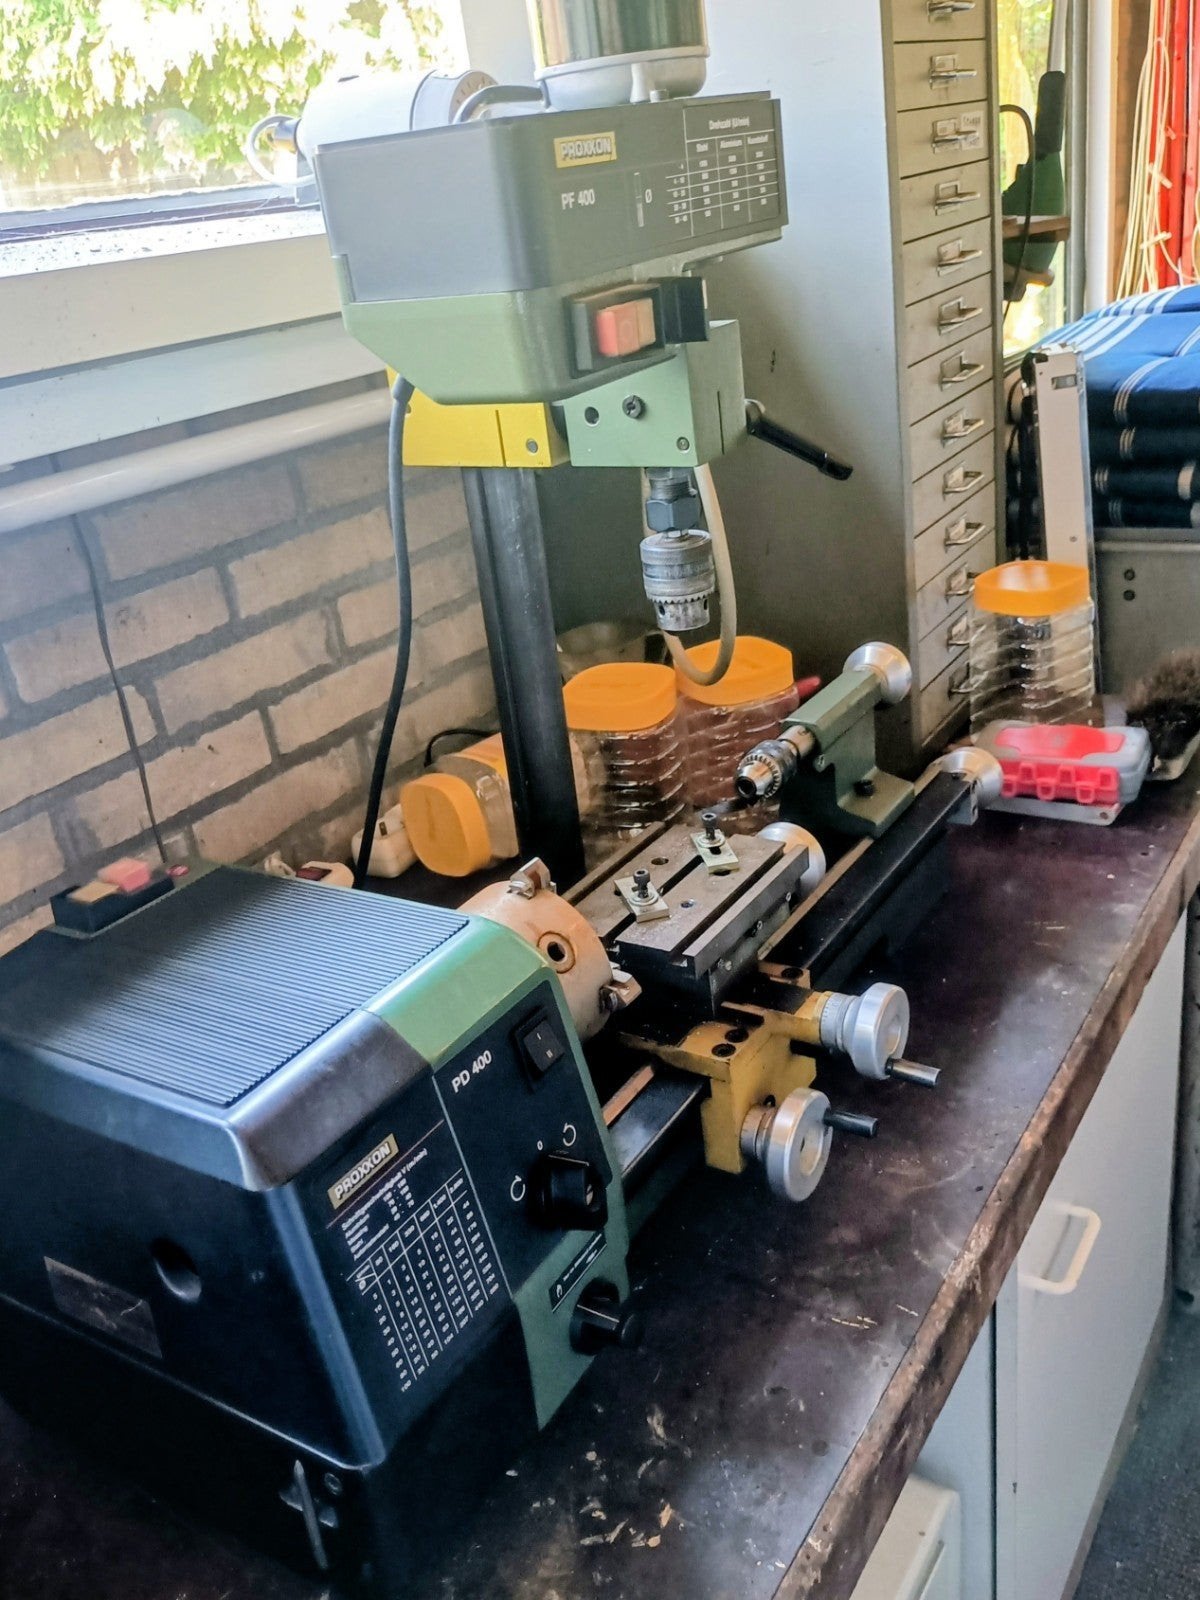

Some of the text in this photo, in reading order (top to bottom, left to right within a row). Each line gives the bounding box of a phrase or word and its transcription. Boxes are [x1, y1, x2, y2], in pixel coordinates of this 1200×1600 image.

[560, 137, 612, 158] PROXXON
[561, 188, 596, 210] PF 400
[451, 1050, 492, 1093] PD 400
[334, 1142, 391, 1200] PROXXON
[374, 1304, 383, 1314] 10
